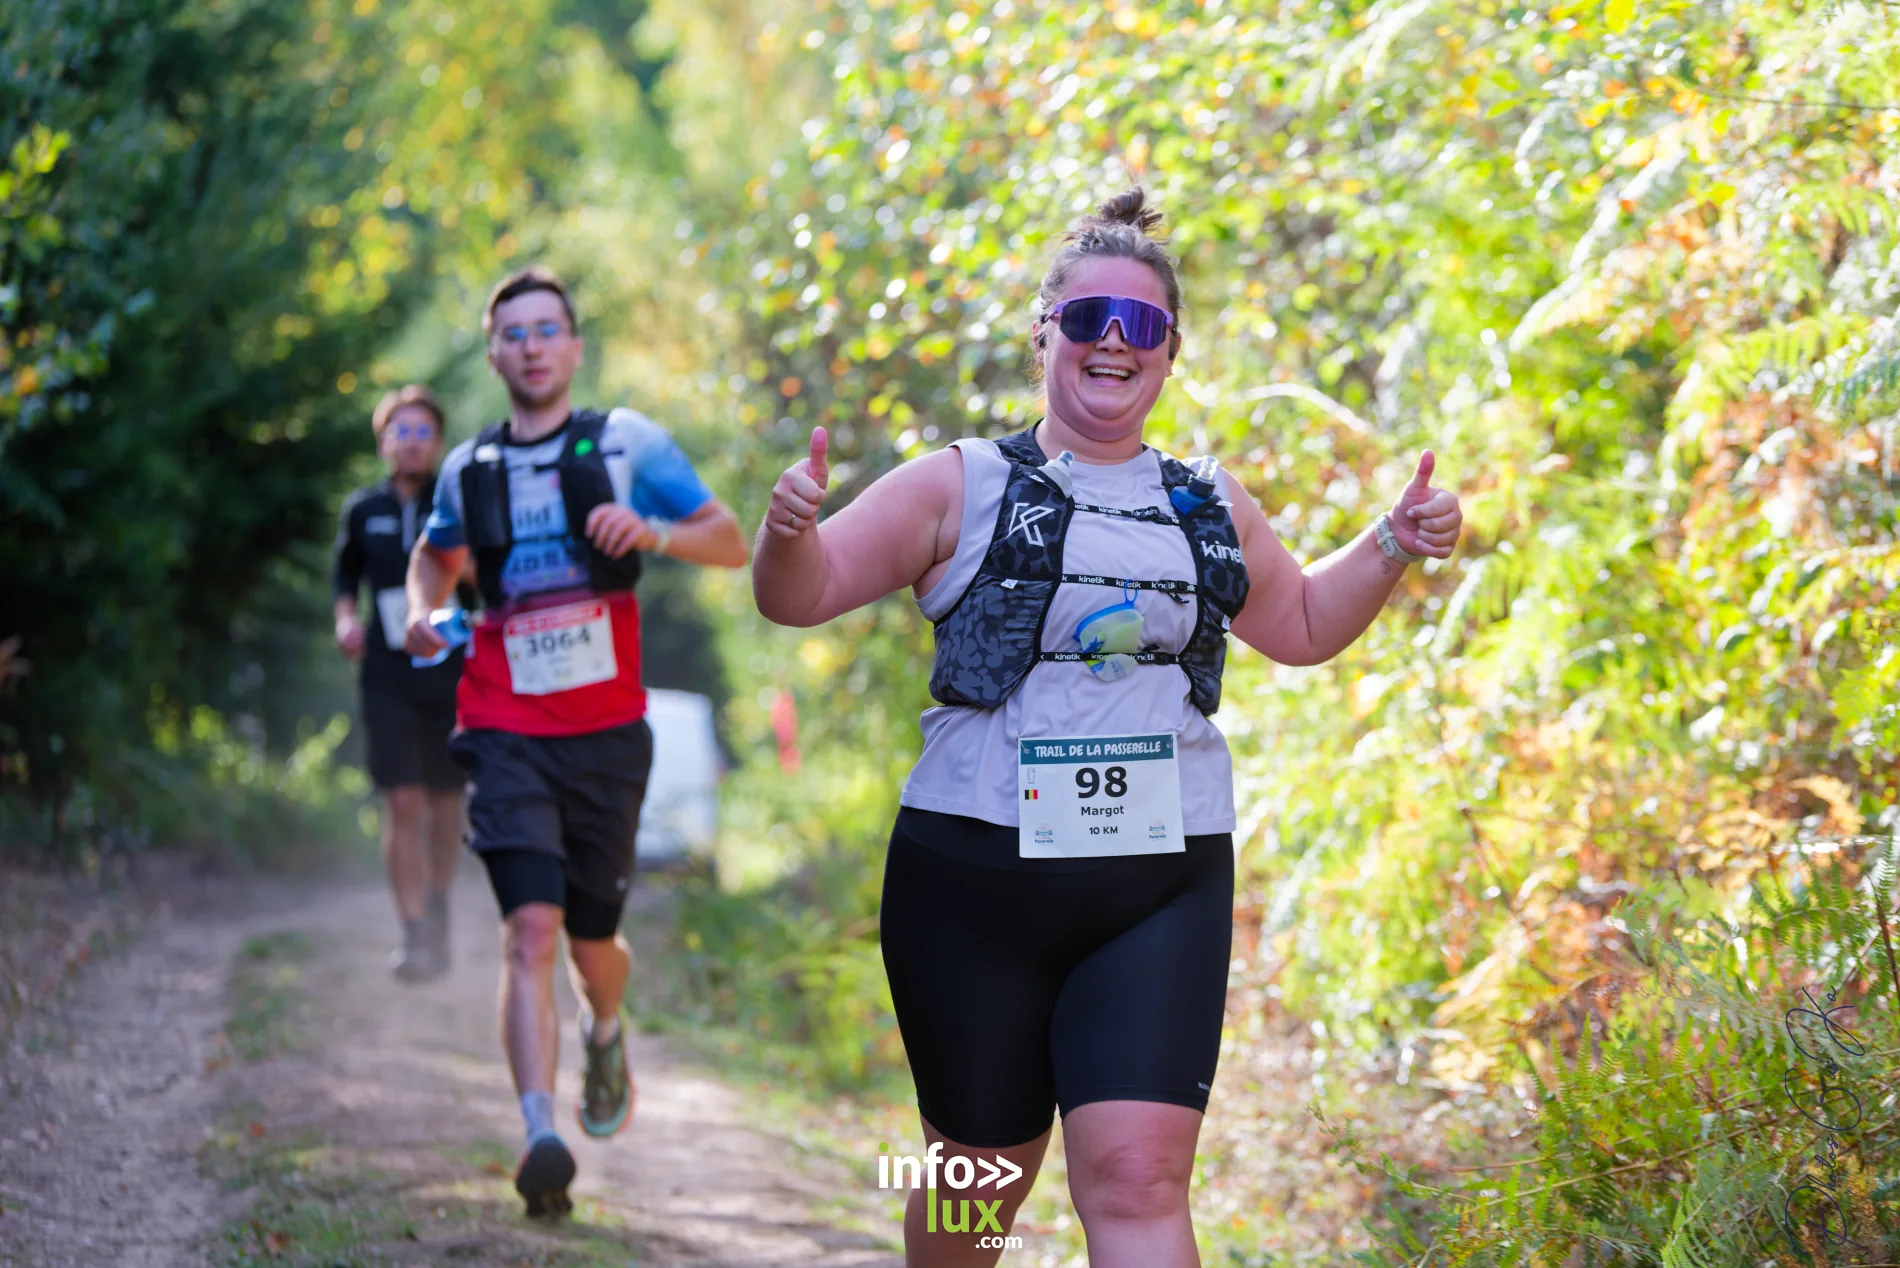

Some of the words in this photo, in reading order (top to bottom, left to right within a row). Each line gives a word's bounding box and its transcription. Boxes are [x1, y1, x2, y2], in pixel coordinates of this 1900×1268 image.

[1098, 506, 1123, 515] kinetik
[1078, 575, 1105, 585] kinetik
[526, 625, 592, 658] 3064
[1054, 653, 1081, 661] kinetik
[1034, 745, 1067, 758] TRAIL
[1069, 744, 1084, 757] DE
[1086, 743, 1101, 756] LA
[1104, 741, 1161, 755] PASSERELLE
[1075, 766, 1128, 799] 98
[1080, 805, 1125, 817] Margot
[1088, 827, 1100, 835] 10
[1103, 826, 1118, 835] KM
